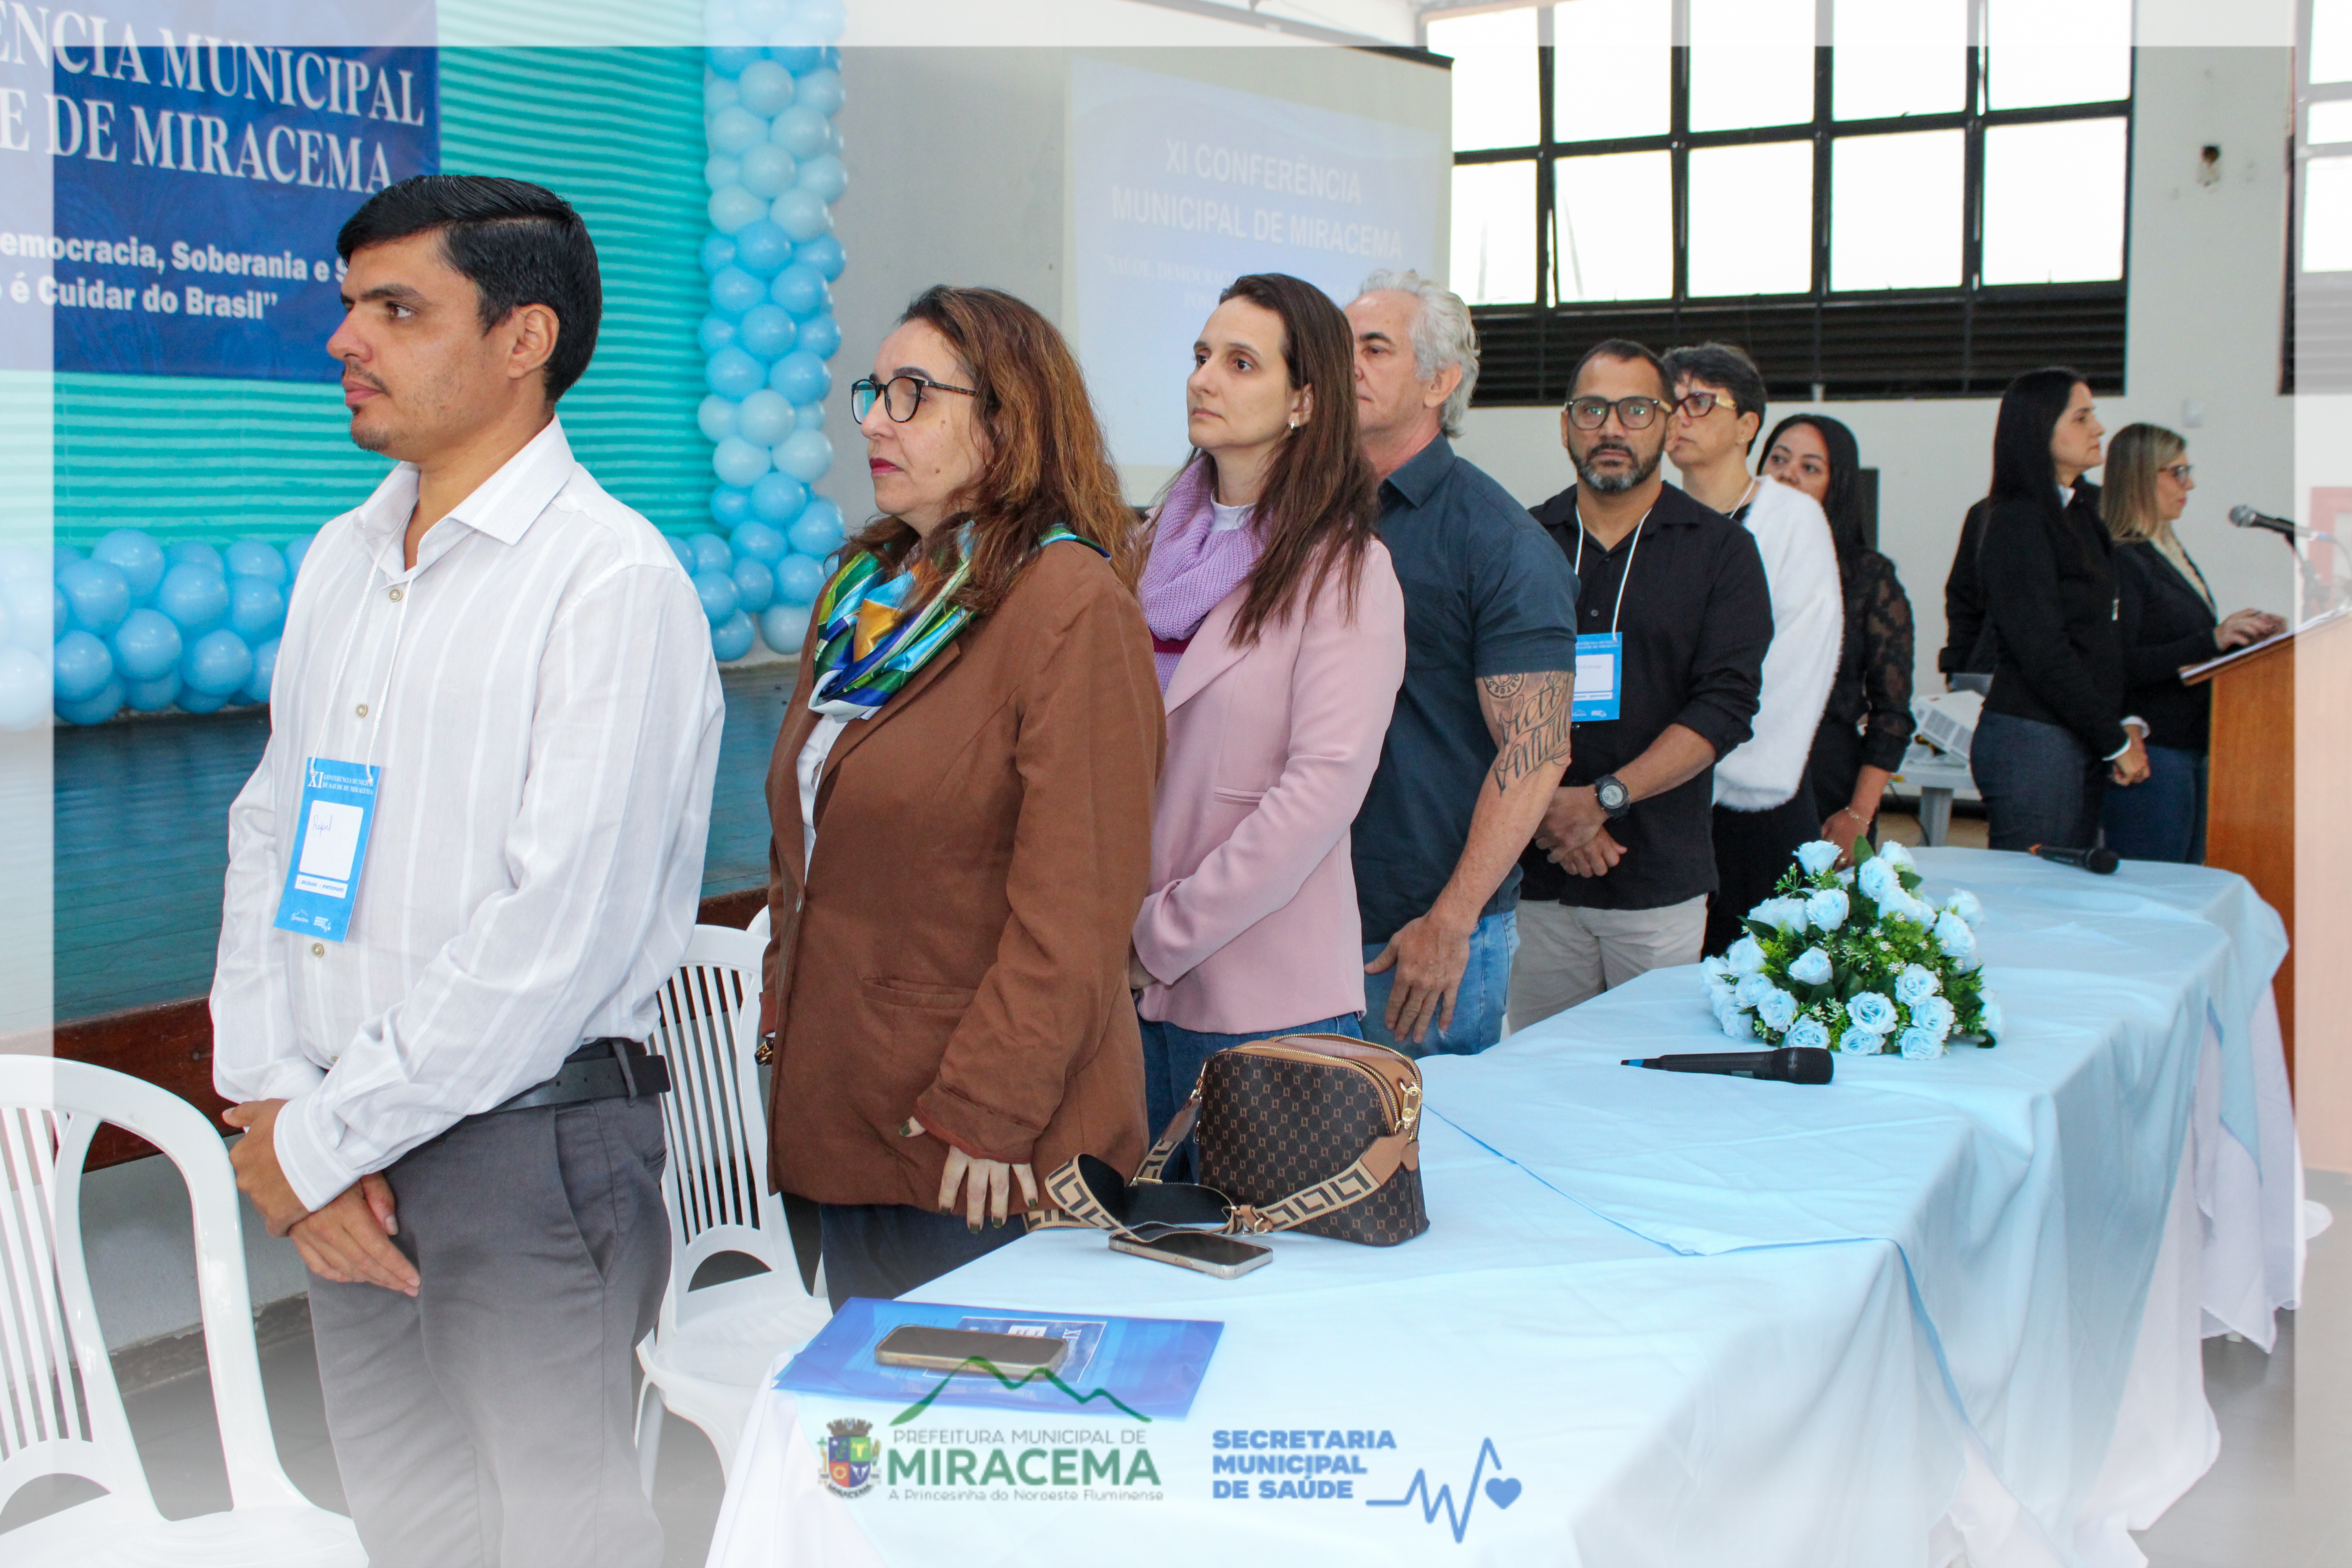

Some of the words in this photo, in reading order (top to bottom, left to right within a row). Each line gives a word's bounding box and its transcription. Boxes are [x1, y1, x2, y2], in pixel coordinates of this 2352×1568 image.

[0, 0, 151, 85] NCIA
[158, 27, 425, 126] MUNICIPAL
[43, 93, 118, 163] DE
[130, 105, 392, 194] MIRACEMA
[1165, 138, 1187, 174] XI
[1194, 143, 1363, 205] CONFERÊNCIA
[1112, 186, 1248, 239] MUNICIPAL
[1254, 209, 1283, 244] DE
[1289, 214, 1403, 260] MIRACEMA
[10, 271, 31, 304] é
[37, 276, 136, 311] Cuidar
[142, 283, 180, 314] do
[171, 240, 309, 281] Soberania
[314, 260, 330, 283] e
[307, 771, 324, 788] XI
